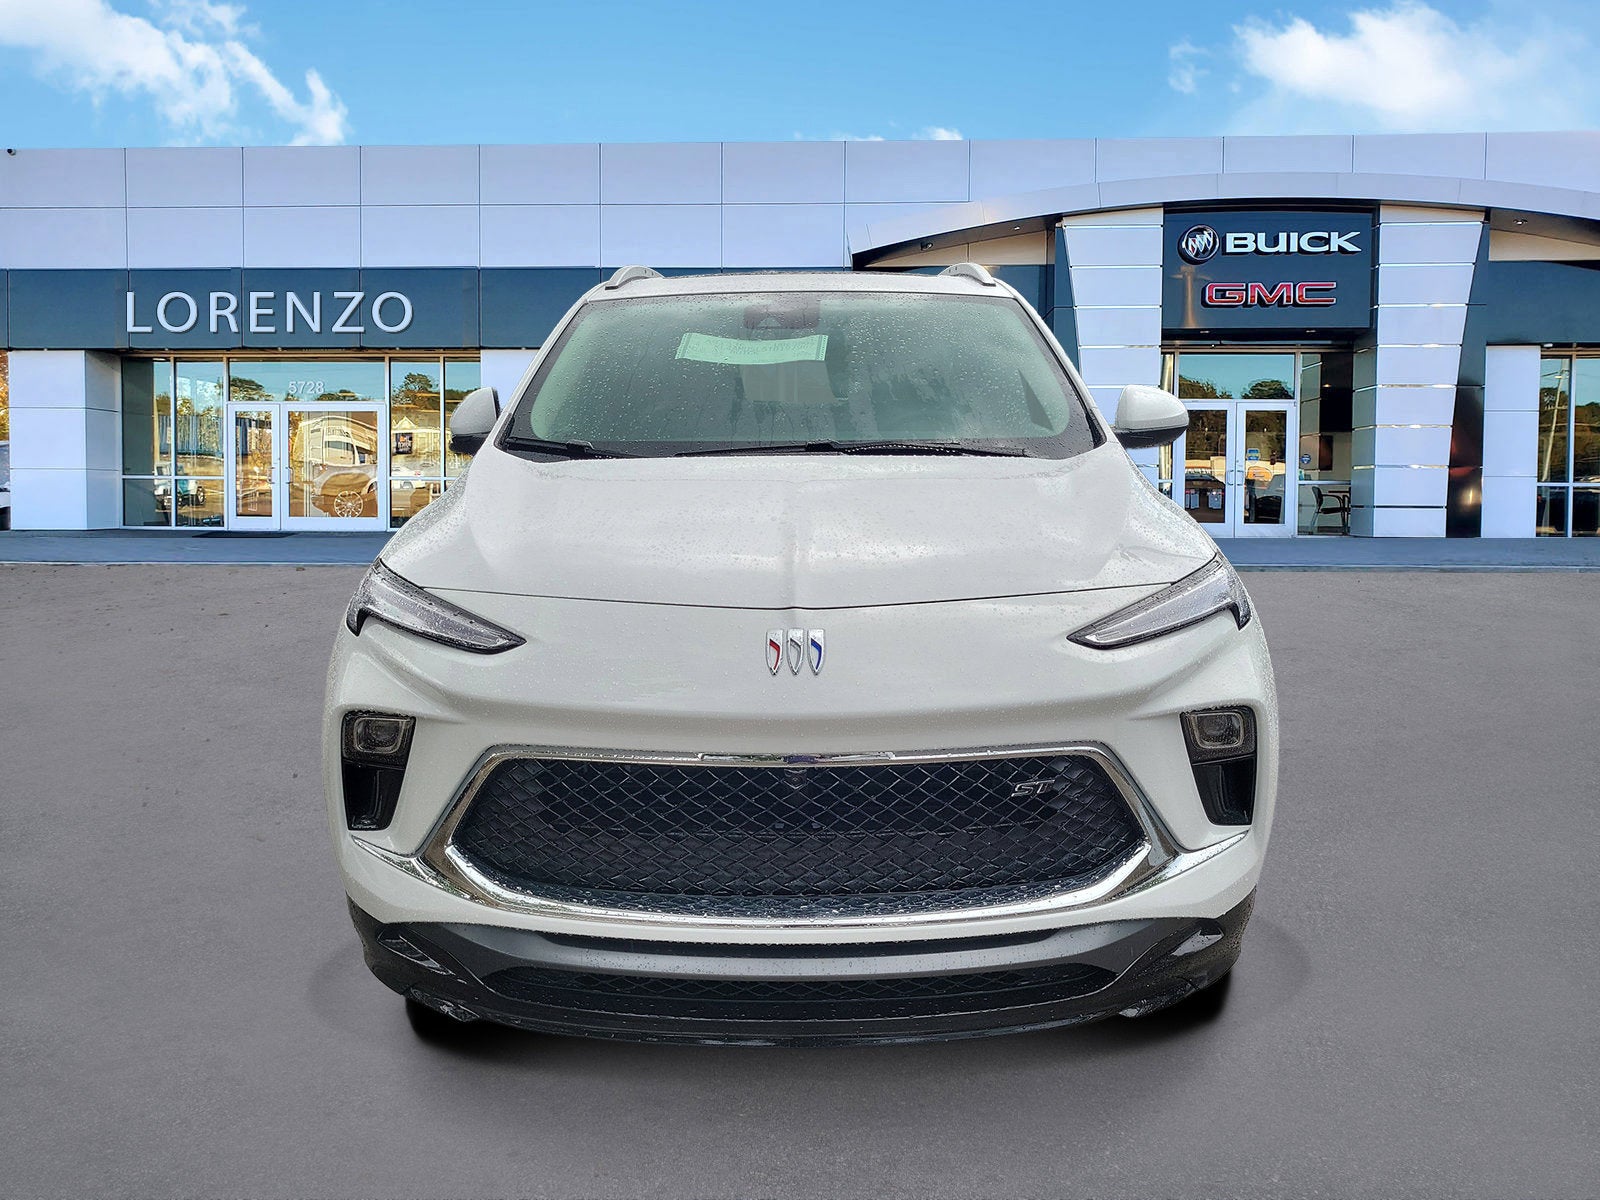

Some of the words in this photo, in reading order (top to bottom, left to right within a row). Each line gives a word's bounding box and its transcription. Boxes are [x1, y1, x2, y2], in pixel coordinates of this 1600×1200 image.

[1225, 231, 1362, 253] BUICK
[1205, 281, 1337, 306] GMC
[126, 291, 413, 333] LORENZO
[288, 380, 325, 394] 5728
[1010, 779, 1056, 797] ST
